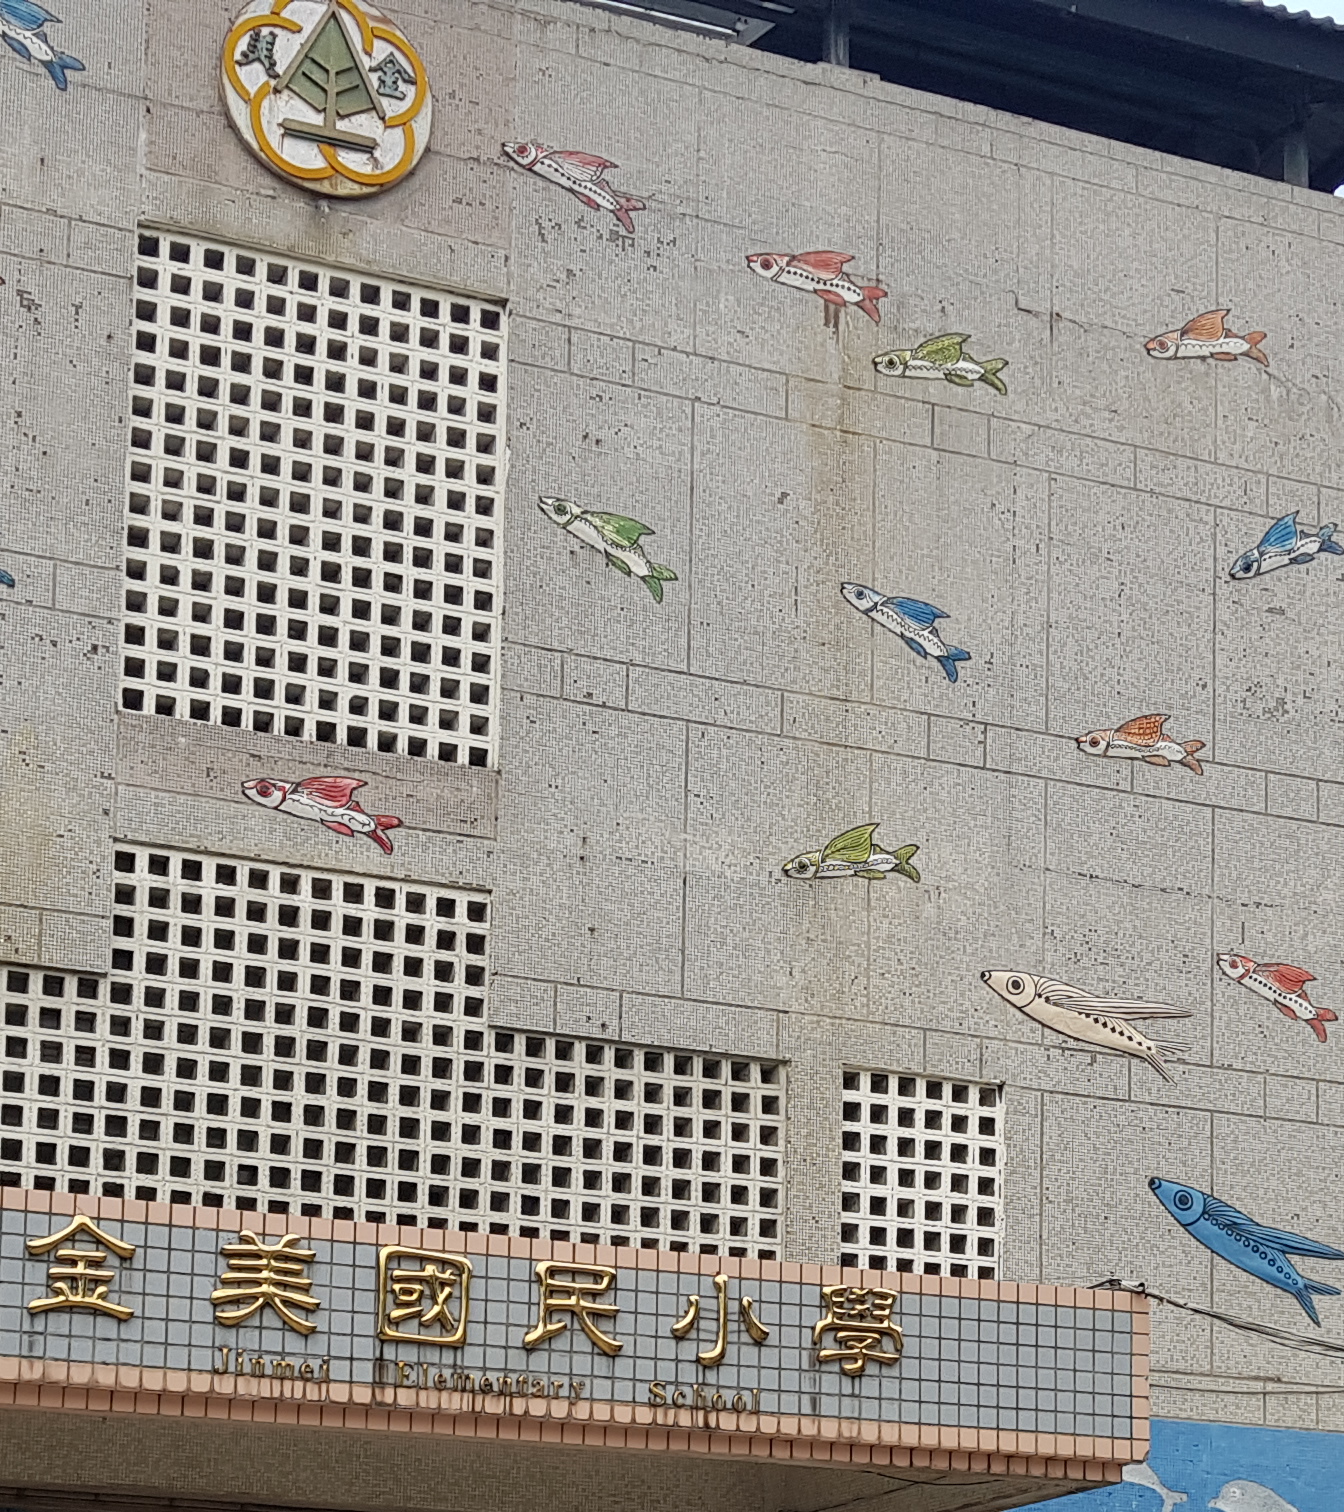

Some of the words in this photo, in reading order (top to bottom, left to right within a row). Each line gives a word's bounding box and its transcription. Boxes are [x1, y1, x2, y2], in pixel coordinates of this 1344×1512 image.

[368, 52, 416, 100] 金
[25, 1213, 903, 1376] 金美國民小學
[213, 1344, 330, 1383] Jinmei
[395, 1360, 587, 1405] Elementary
[648, 1380, 761, 1414] School
